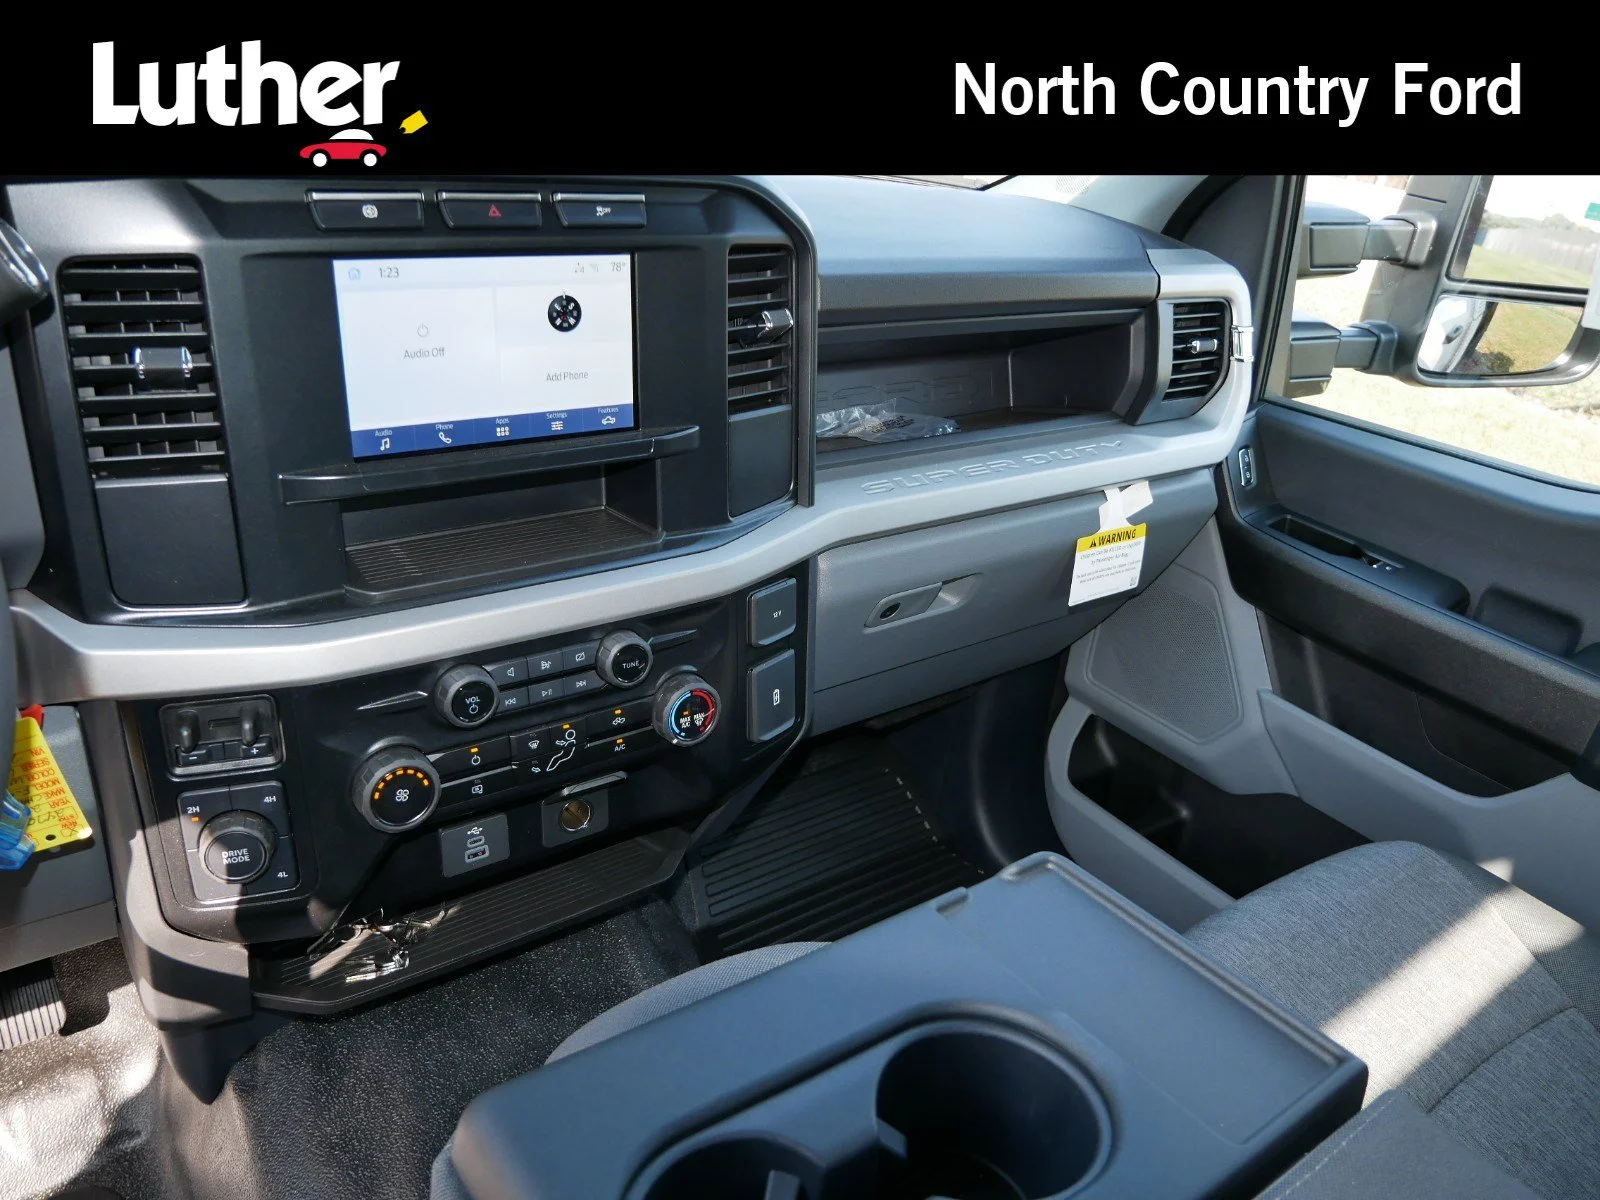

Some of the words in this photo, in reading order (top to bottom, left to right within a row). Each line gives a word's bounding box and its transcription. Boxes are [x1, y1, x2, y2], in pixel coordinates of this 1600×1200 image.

[378, 267, 399, 279] 1:23
[403, 347, 428, 359] Audio
[430, 347, 445, 358] Off
[545, 372, 562, 383] Add
[563, 370, 589, 381] Phone
[546, 411, 567, 420] Settings
[495, 417, 509, 425] Apps
[435, 422, 453, 431] Phone
[374, 428, 393, 437] Audio
[860, 459, 1020, 495] SUPER
[1022, 440, 1122, 466] DUTY
[1098, 529, 1136, 546] WARNING
[622, 661, 640, 669] TUNE
[464, 696, 481, 704] VOL
[31, 748, 45, 757] VIN
[614, 743, 626, 752] A/C
[27, 768, 55, 781] COLOR
[34, 778, 60, 791] MODEL
[43, 787, 65, 800] MAKE
[48, 797, 70, 809] YEAR
[263, 795, 277, 804] 4H
[187, 805, 200, 814] 2H
[221, 848, 248, 859] DRIVE
[223, 854, 250, 865] MODE
[277, 871, 288, 879] 4L
